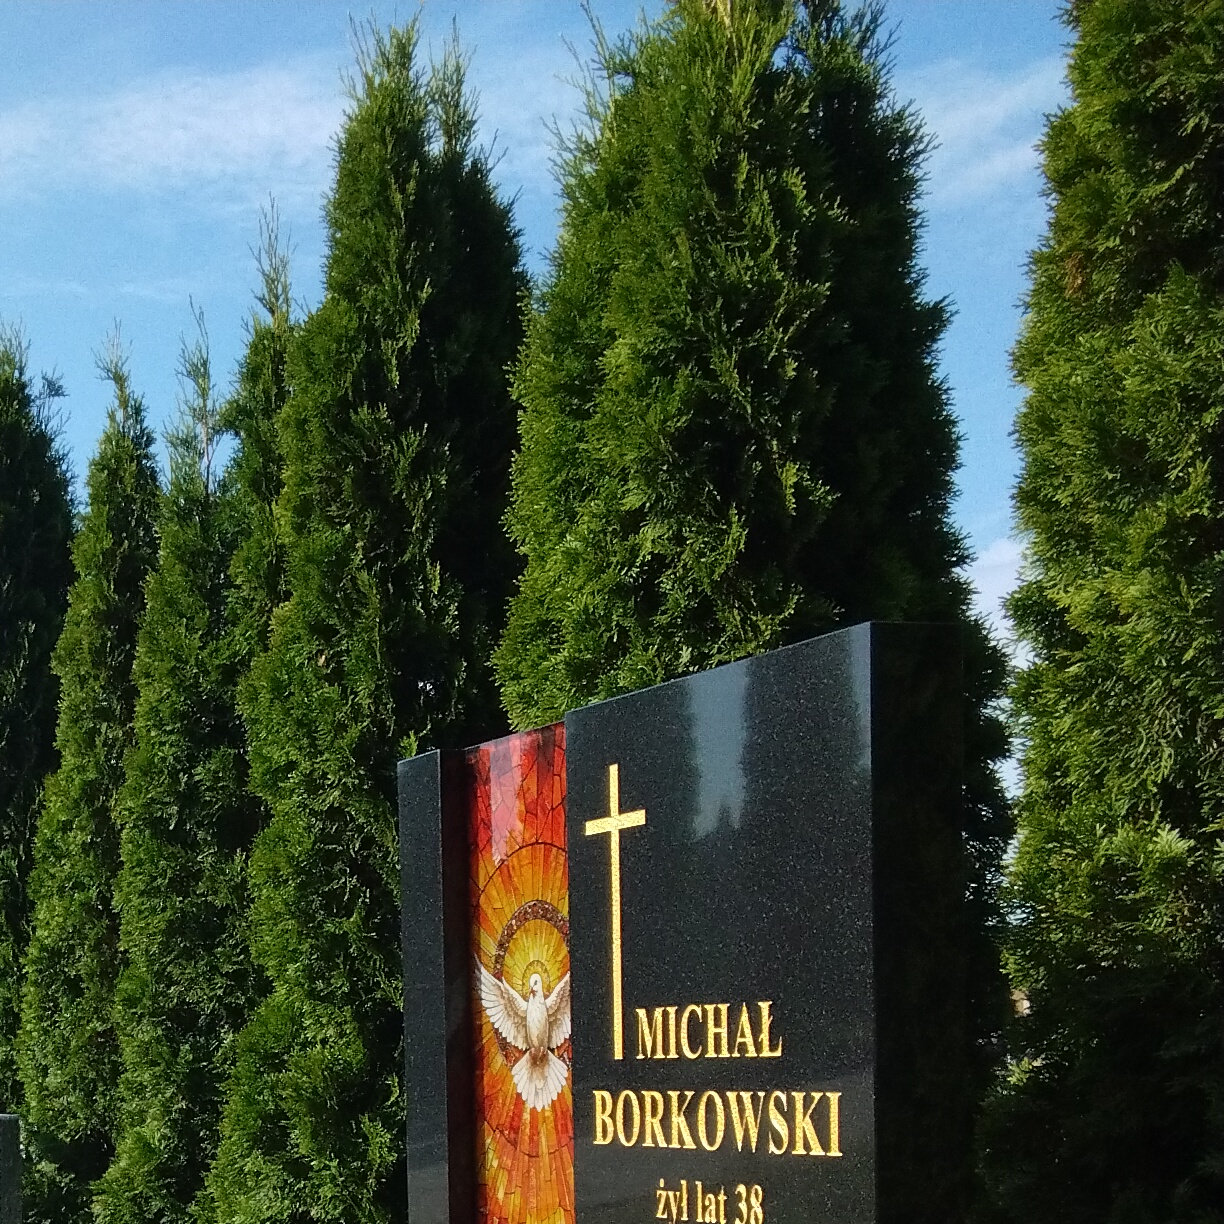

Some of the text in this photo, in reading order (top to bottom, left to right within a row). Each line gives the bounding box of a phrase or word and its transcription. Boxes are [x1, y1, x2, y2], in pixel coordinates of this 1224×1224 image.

[635, 1000, 783, 1060] MICHAŁ
[592, 1089, 843, 1157] BORKOWSKI
[695, 1181, 727, 1224] lat
